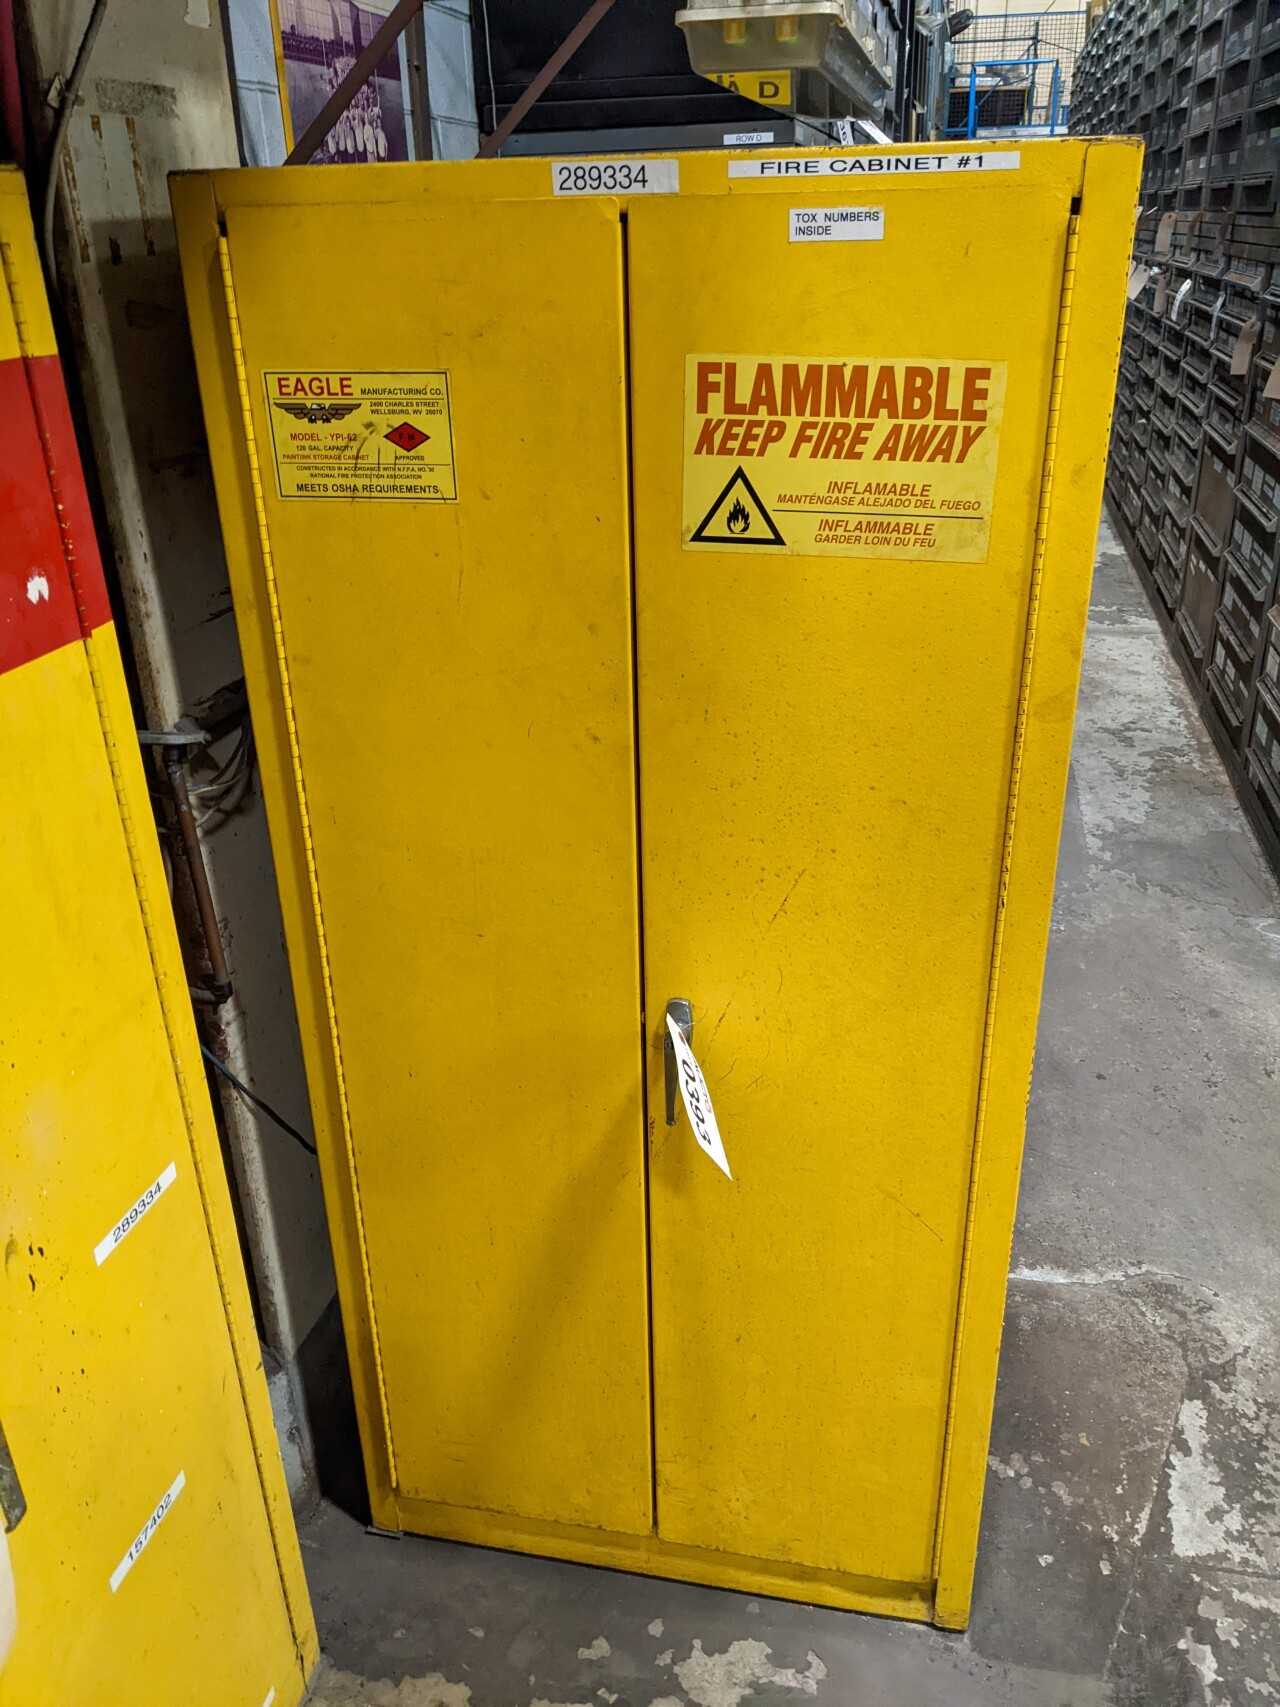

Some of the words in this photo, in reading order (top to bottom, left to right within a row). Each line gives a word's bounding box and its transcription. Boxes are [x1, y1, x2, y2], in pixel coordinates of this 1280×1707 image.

[758, 81, 780, 99] D
[759, 158, 830, 176] FIRE
[834, 155, 950, 174] CABINET
[956, 155, 986, 170] #1
[558, 164, 649, 191] 289334
[795, 213, 818, 225] TOX
[824, 210, 881, 224] NUMBERS
[795, 225, 833, 237] INSIDE
[277, 376, 355, 397] EAGLE
[360, 387, 429, 397] MANUFACTURING
[429, 387, 444, 397] CO.
[696, 361, 992, 422] FLAMMABLE
[290, 432, 322, 442] MODEL
[694, 418, 787, 457] KEEP
[788, 421, 874, 461] FIRE
[873, 423, 989, 464] AWAY
[296, 484, 329, 493] MEETS
[331, 484, 360, 494] OSHA
[362, 484, 439, 495] REQUIREMENTS
[827, 480, 932, 498] INFLAMABLE
[857, 495, 911, 510] ALEJADO
[914, 497, 939, 510] DEL
[940, 498, 982, 512] FUEGO
[818, 518, 935, 537] INFLAMMABLE
[814, 533, 863, 546] GARDER
[864, 534, 892, 547] LOIN
[893, 535, 910, 547] DU
[911, 536, 937, 549] FEU
[113, 1181, 163, 1244] 289334
[127, 1493, 172, 1562] 157402
